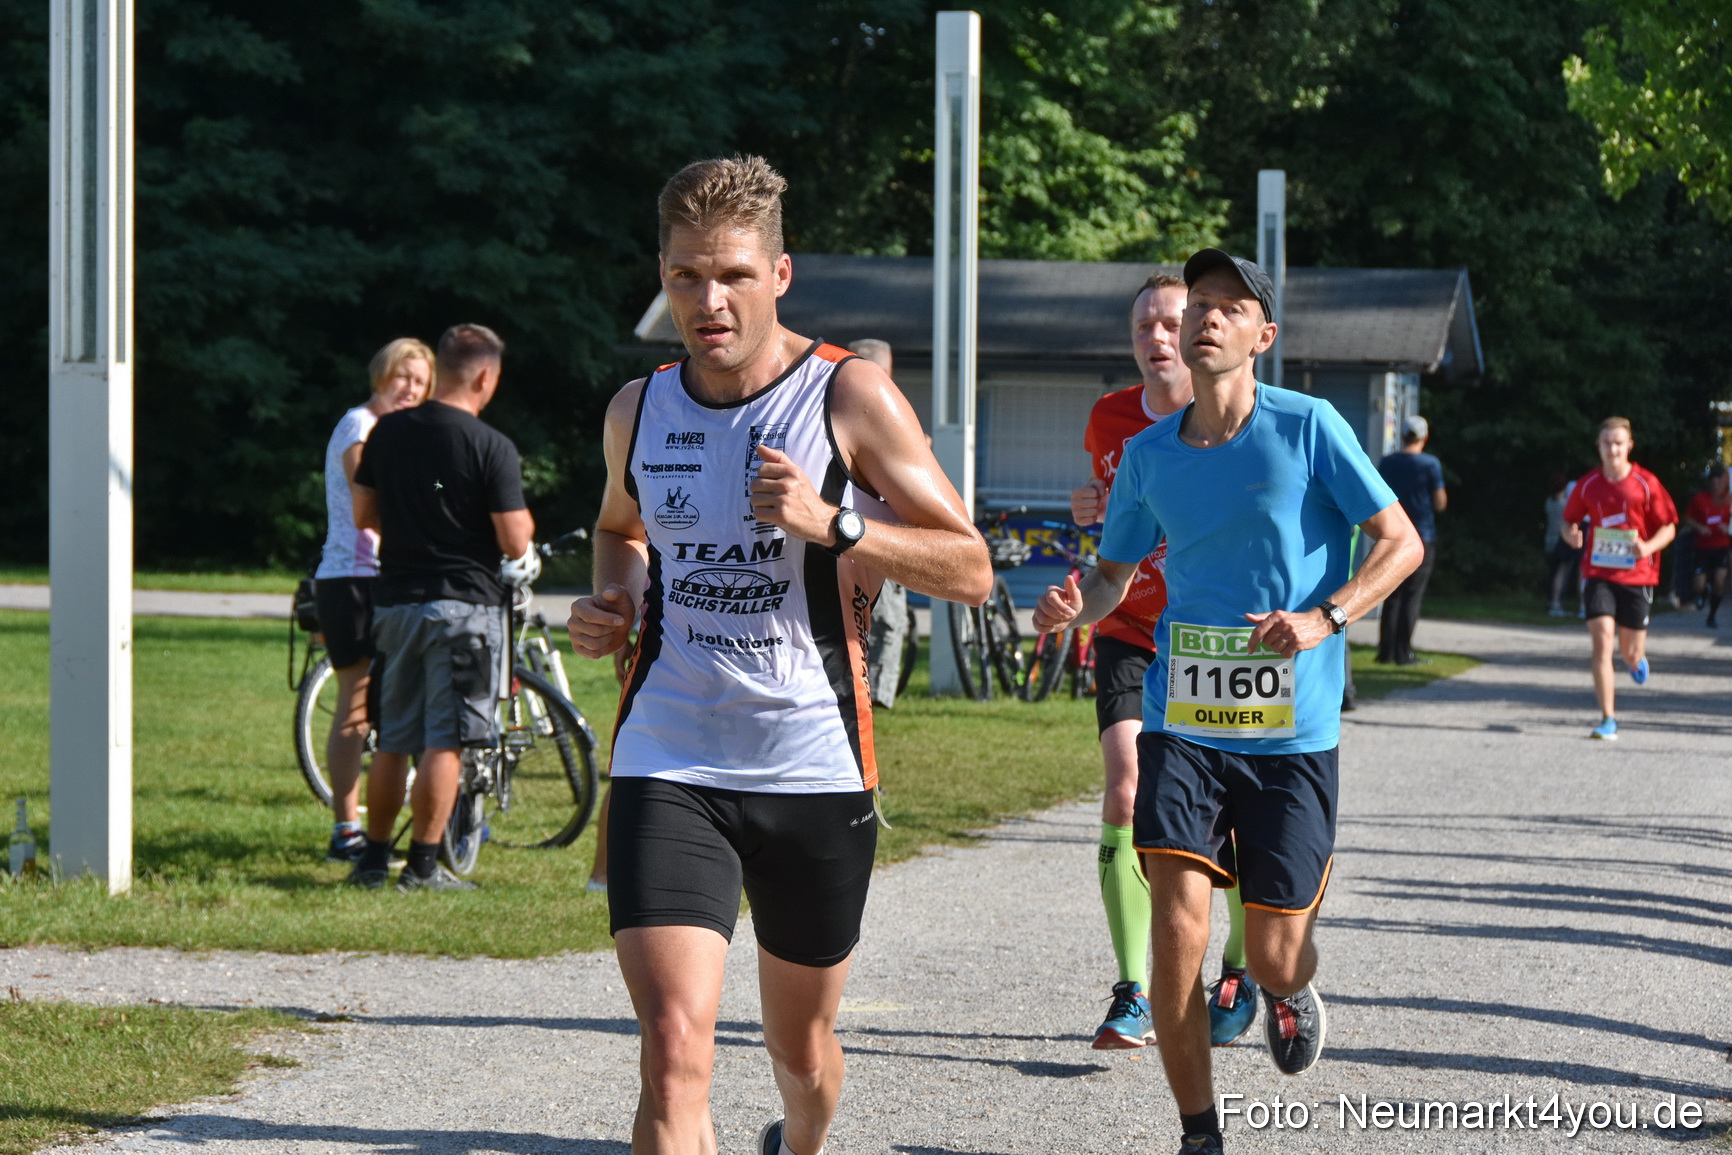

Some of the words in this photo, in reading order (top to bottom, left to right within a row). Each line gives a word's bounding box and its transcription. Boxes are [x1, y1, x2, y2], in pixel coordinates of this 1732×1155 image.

[672, 538, 785, 563] TEAM
[673, 580, 788, 598] RADSPORT
[1126, 585, 1158, 601] utdoor
[668, 591, 784, 615] BUCHSTALLER
[1184, 664, 1280, 700] 1160
[1195, 709, 1265, 725] OLIVER
